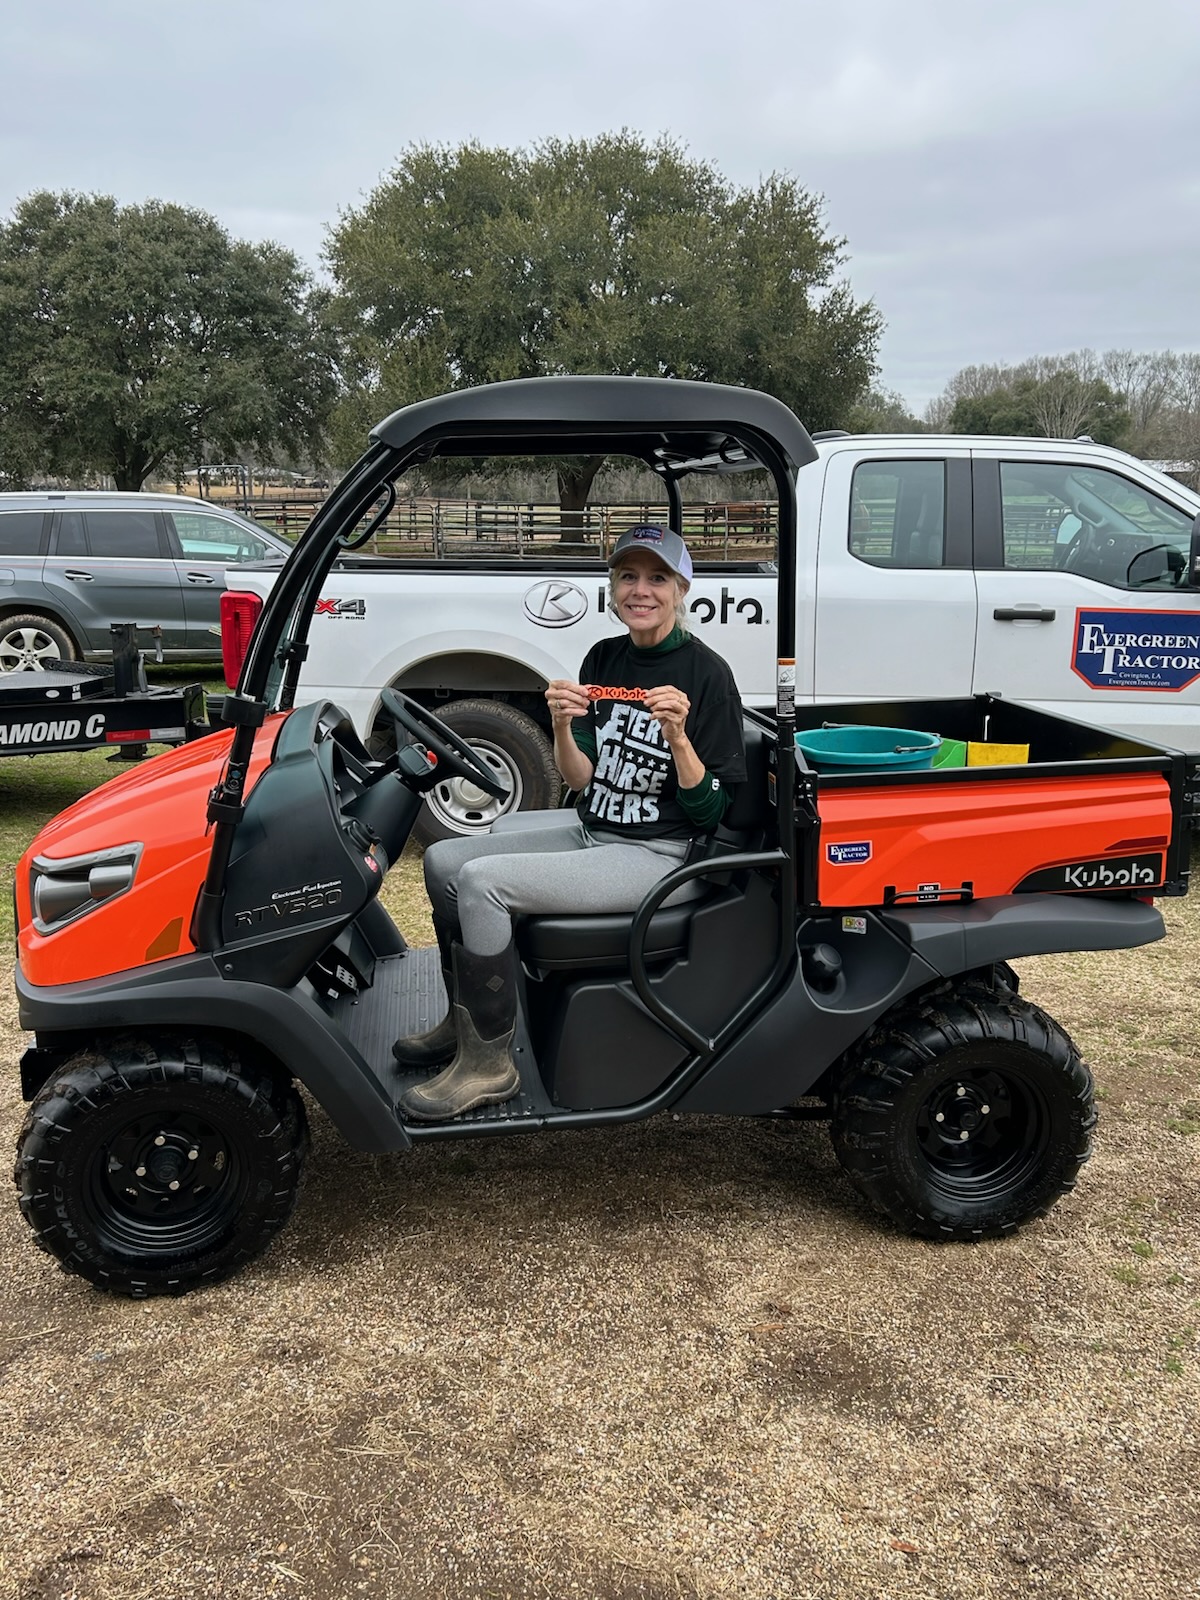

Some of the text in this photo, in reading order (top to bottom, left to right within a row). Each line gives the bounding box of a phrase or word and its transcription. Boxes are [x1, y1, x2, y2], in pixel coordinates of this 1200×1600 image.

[313, 598, 366, 615] X4
[598, 586, 763, 624] Kota
[1079, 623, 1200, 654] EVERGREEN
[1094, 645, 1200, 675] TRACTOR
[1108, 678, 1170, 686] EvergreenTractor.com
[1119, 671, 1151, 679] Covington,
[85, 713, 106, 739] C
[594, 744, 667, 795] HRSE
[837, 851, 868, 861] TRACTOR
[1064, 862, 1155, 887] Kubota
[271, 889, 302, 900] Electronic
[302, 884, 317, 893] Fuel
[234, 889, 342, 929] RTV520
